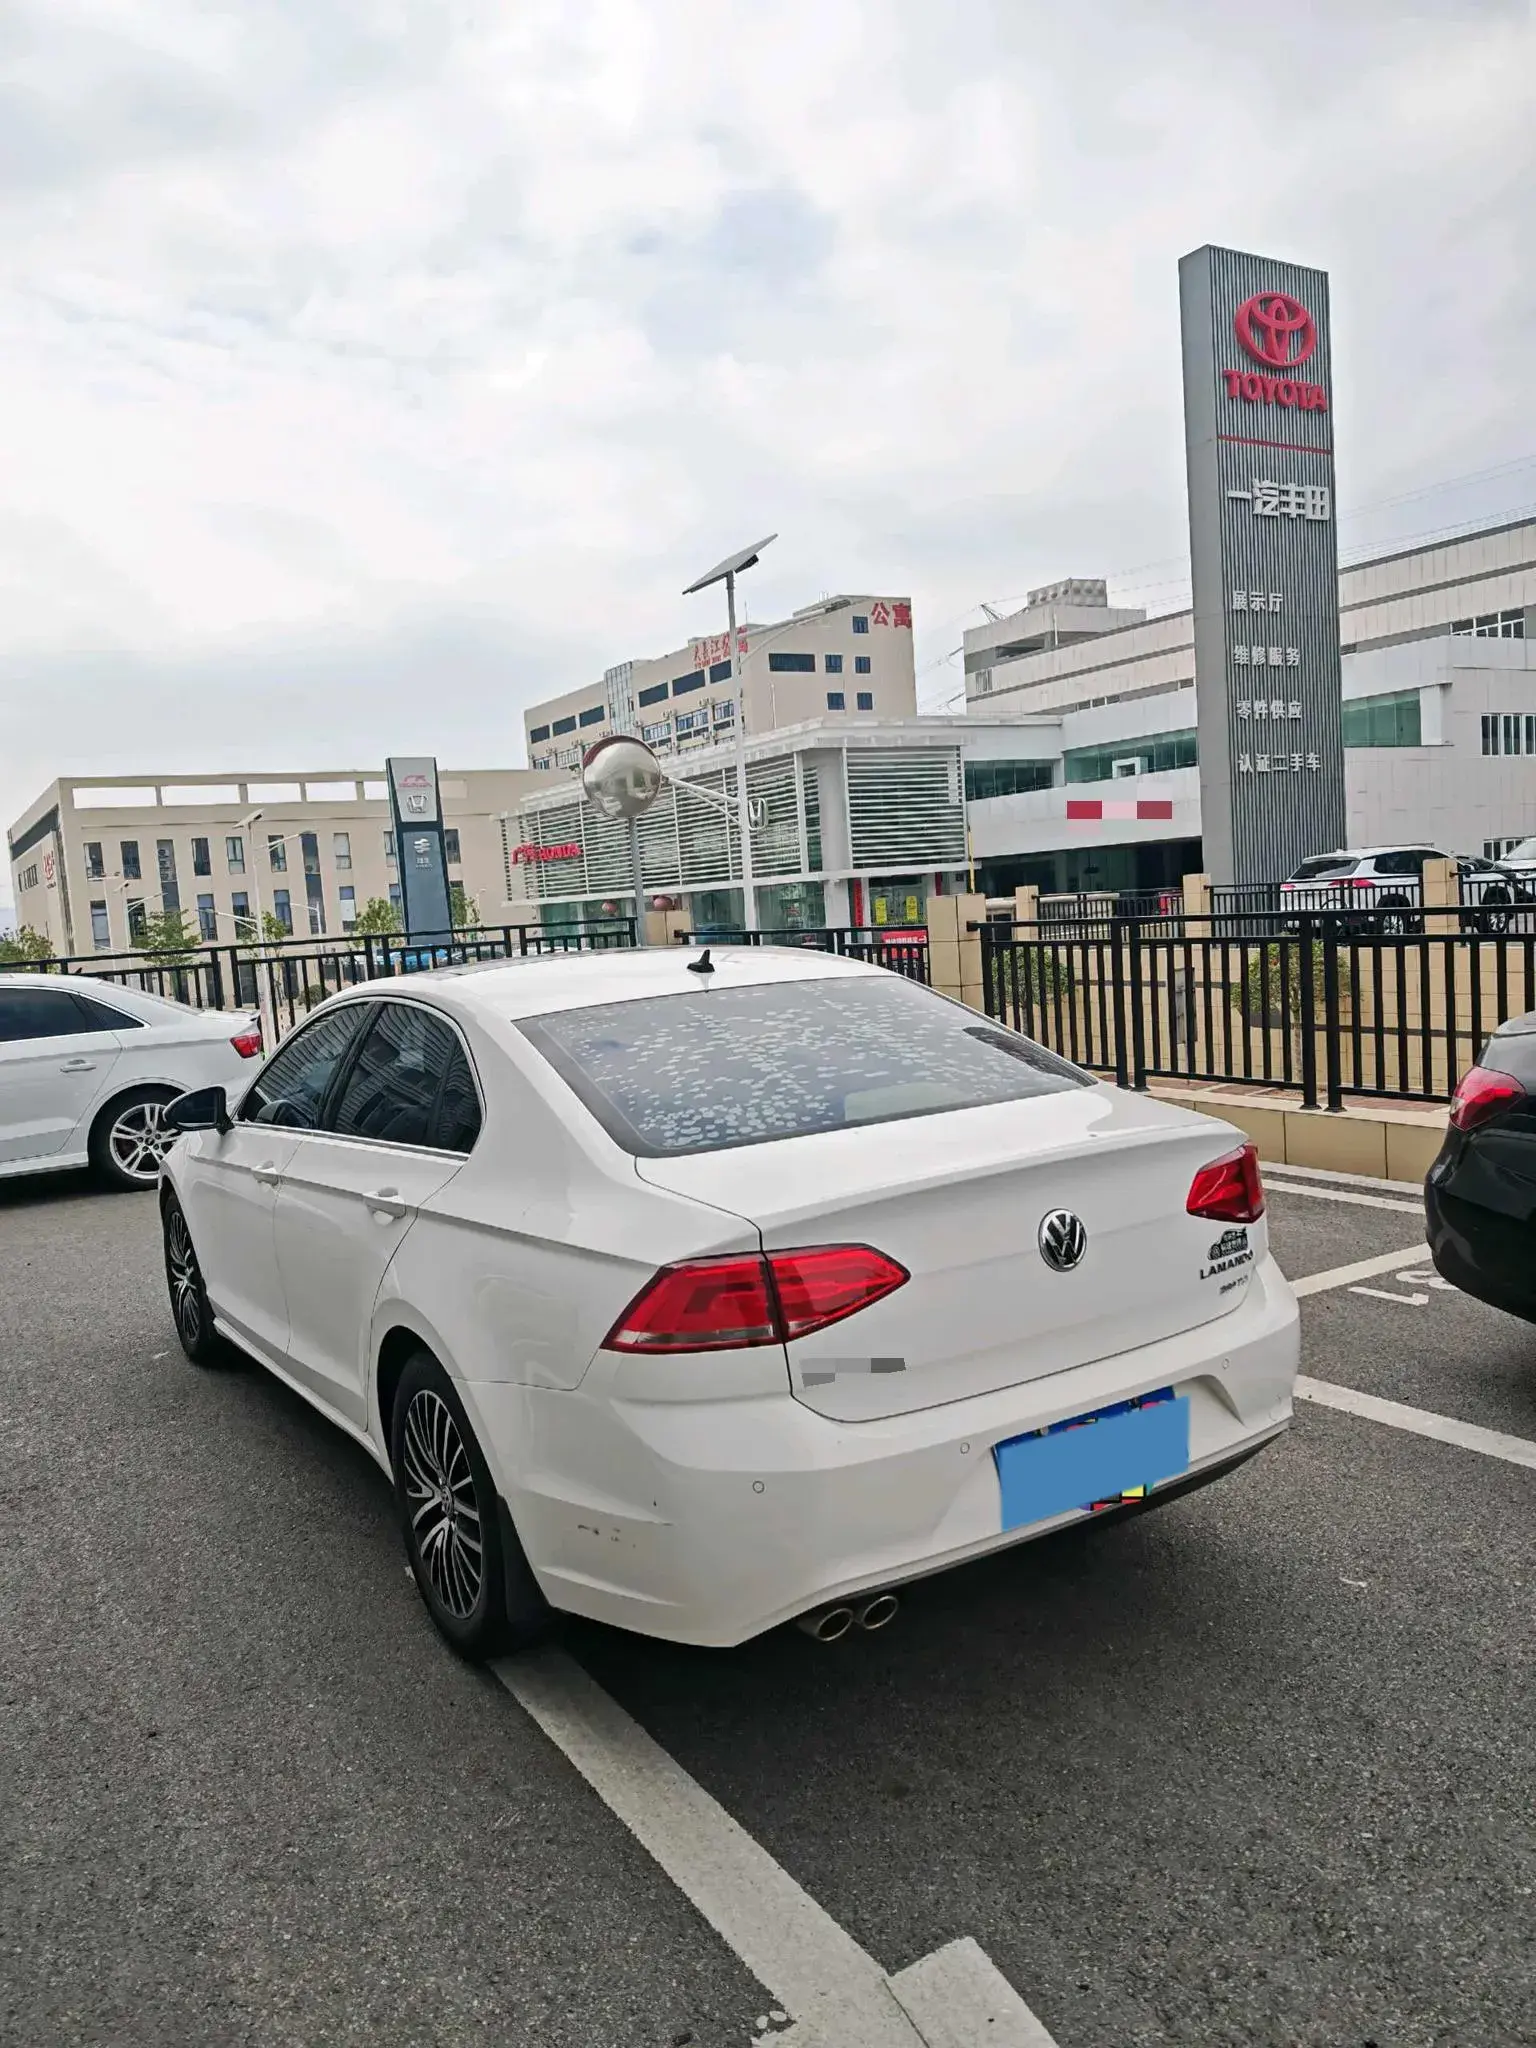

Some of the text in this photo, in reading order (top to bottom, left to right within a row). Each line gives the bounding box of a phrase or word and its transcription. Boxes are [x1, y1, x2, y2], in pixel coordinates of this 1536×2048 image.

[1222, 368, 1328, 414] TOYOTA
[1227, 478, 1330, 521] 一汽丰田
[1232, 590, 1283, 613] 展示厅
[870, 601, 912, 629] 公寓
[1233, 645, 1301, 667] 维修服务
[1236, 700, 1302, 720] 零件供应
[1237, 752, 1322, 773] 认证二手车
